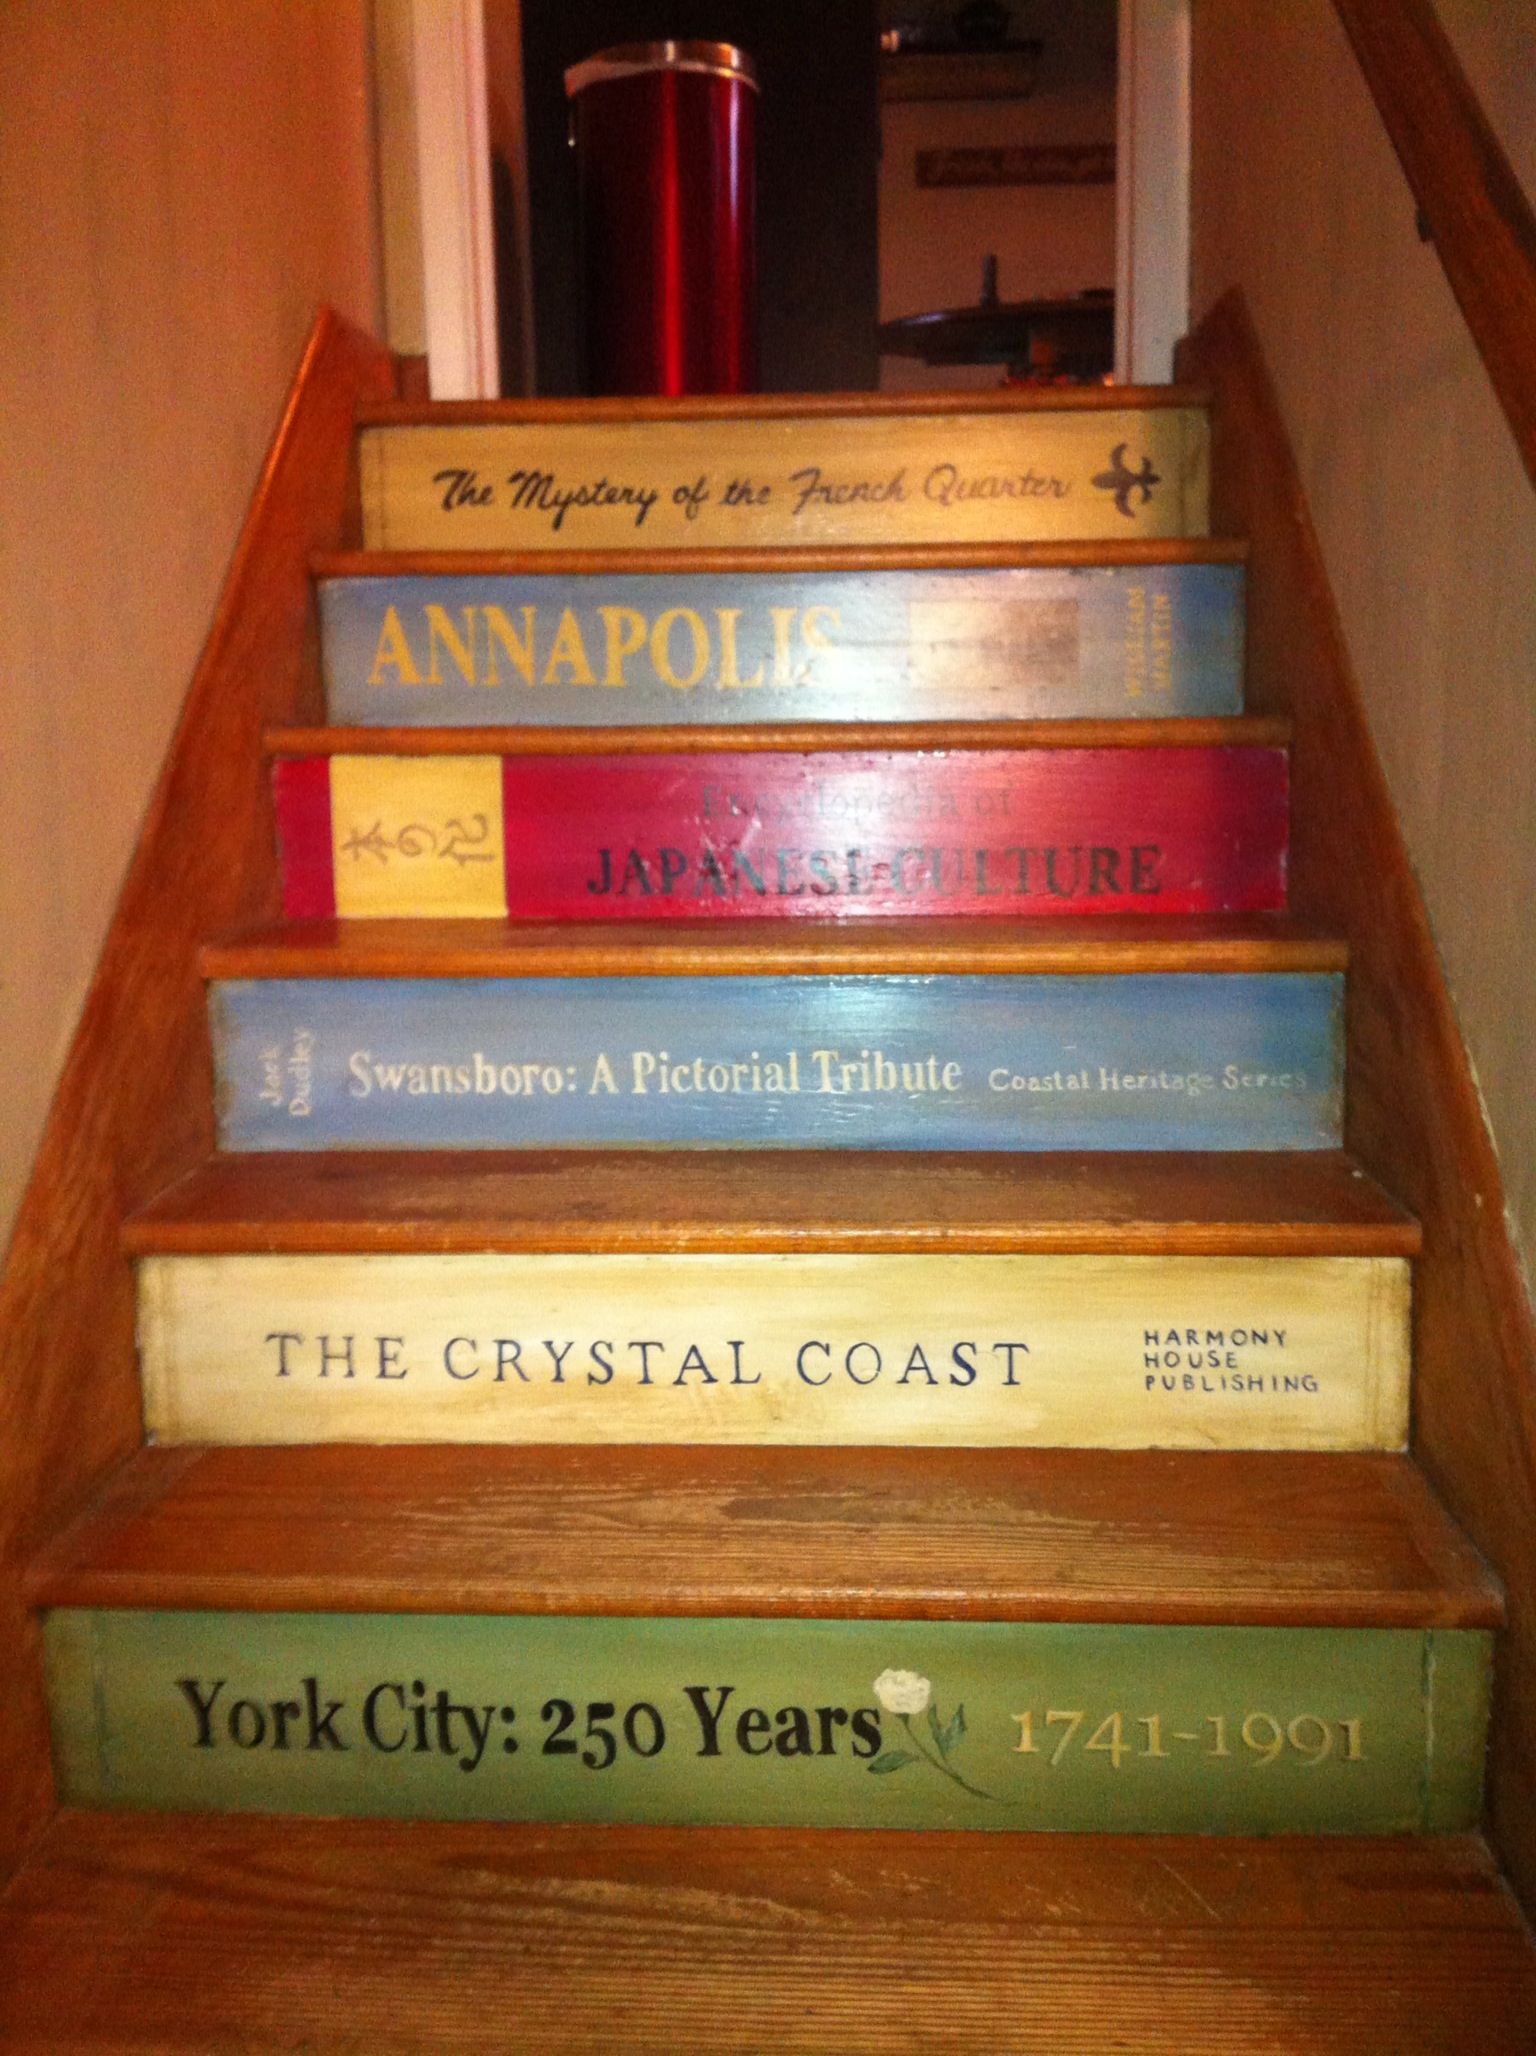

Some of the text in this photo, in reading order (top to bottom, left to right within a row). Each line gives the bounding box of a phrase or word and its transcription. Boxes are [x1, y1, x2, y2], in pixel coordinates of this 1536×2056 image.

[433, 463, 1073, 530] The Mystery of the French Quarter
[367, 603, 844, 690] ANNAPOLIS
[587, 843, 1163, 896] JAPANESE CULTURE
[350, 1050, 1308, 1098] Swansboro: A Pictorial Tribute Coastal Heritage Series
[266, 1333, 1030, 1388] THE CRYSTAL COAST
[1144, 1329, 1287, 1348] HARMONY
[1144, 1350, 1239, 1368] HOUSE
[1144, 1373, 1319, 1393] PUBLISHING
[175, 1677, 1368, 1772] York City: 250 Years 1741-1991
